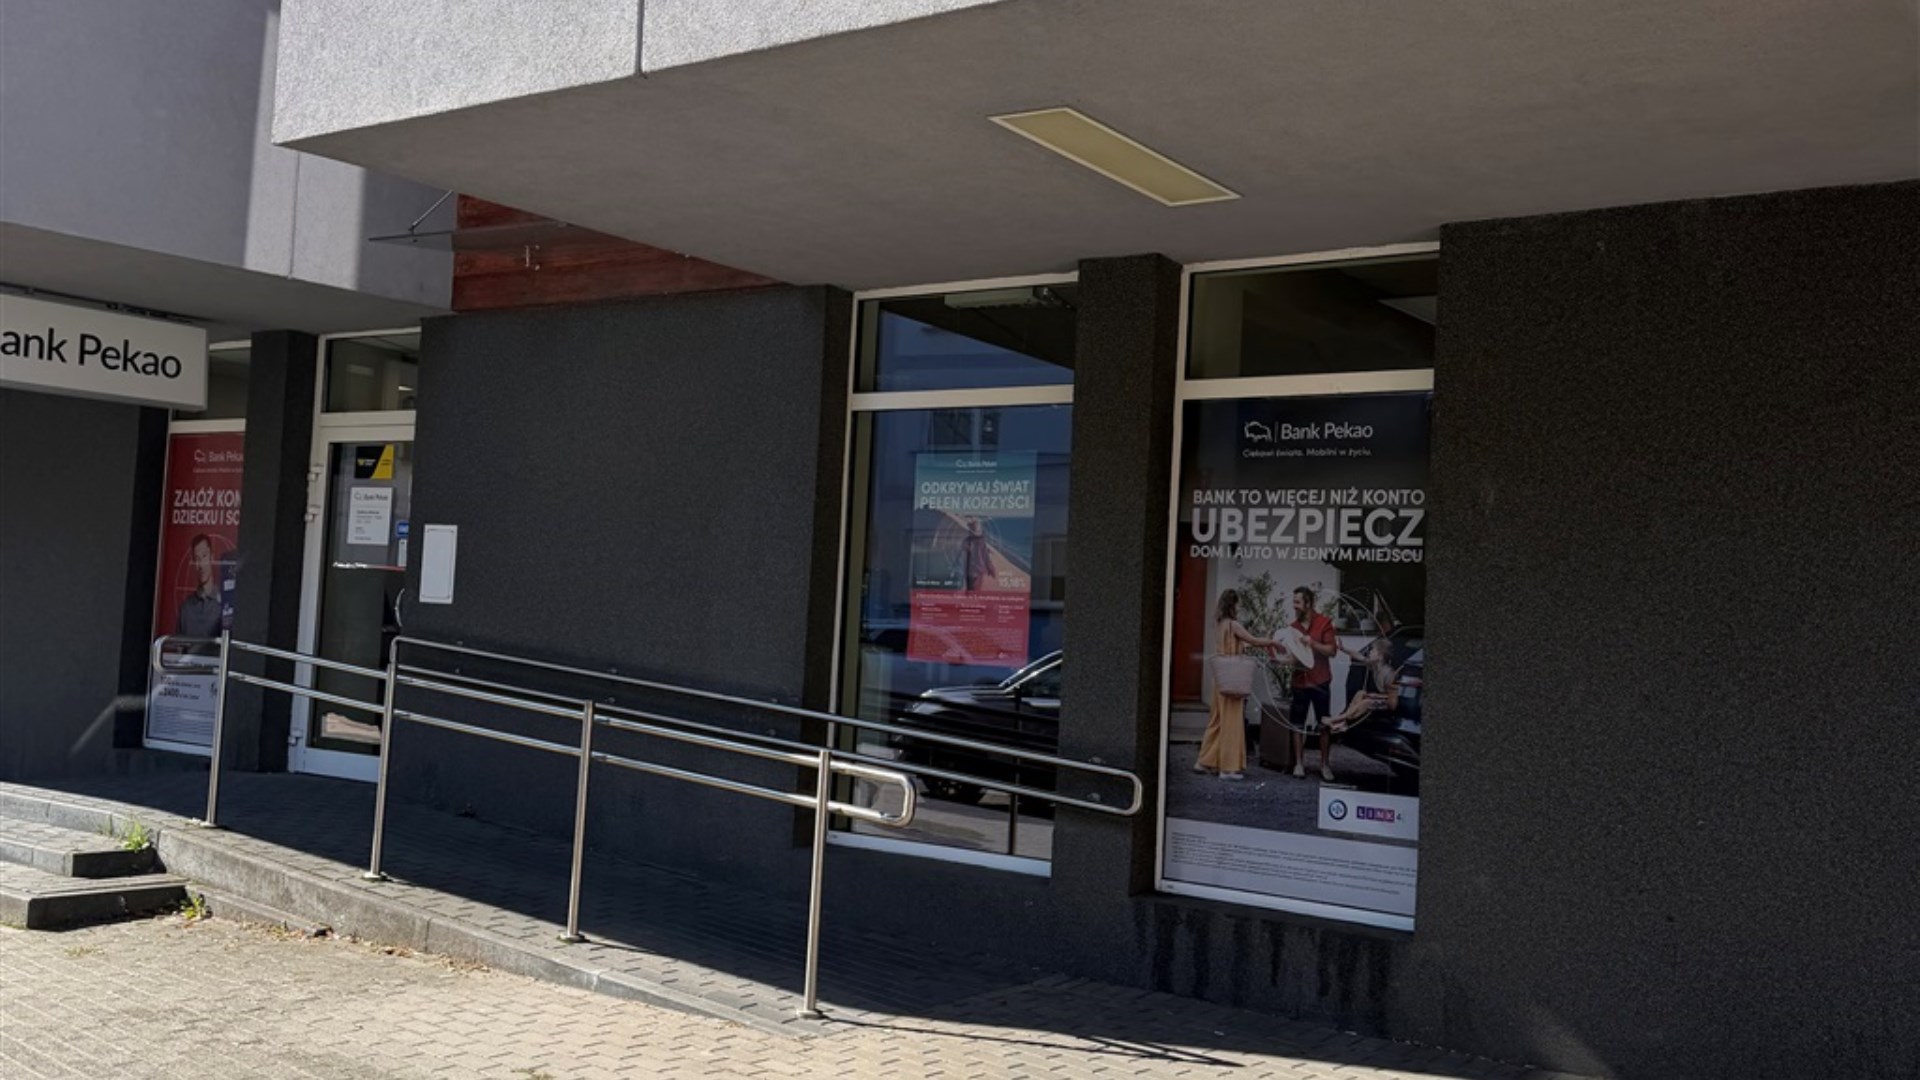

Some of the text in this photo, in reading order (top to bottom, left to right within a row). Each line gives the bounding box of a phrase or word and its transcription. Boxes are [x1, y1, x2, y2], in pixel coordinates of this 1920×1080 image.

[78, 333, 182, 379] Pekao
[1281, 421, 1374, 440] Bank Pekao
[921, 479, 1030, 494] ODKRYWAJ ŚWIAT
[174, 486, 214, 507] ZAŁÓŻ
[963, 494, 1030, 509] KORZYŚCI
[1193, 486, 1425, 508] BANK TO WIĘCEJ NIŻ KONTO
[172, 509, 219, 525] DZIECKU
[1191, 507, 1425, 546] UBEZPIECZ
[1190, 544, 1225, 559] DOM
[1235, 546, 1273, 560] AUTO
[1275, 547, 1288, 560] W
[1291, 547, 1352, 562] JEDNYM
[1356, 548, 1424, 563] MIEJSCU
